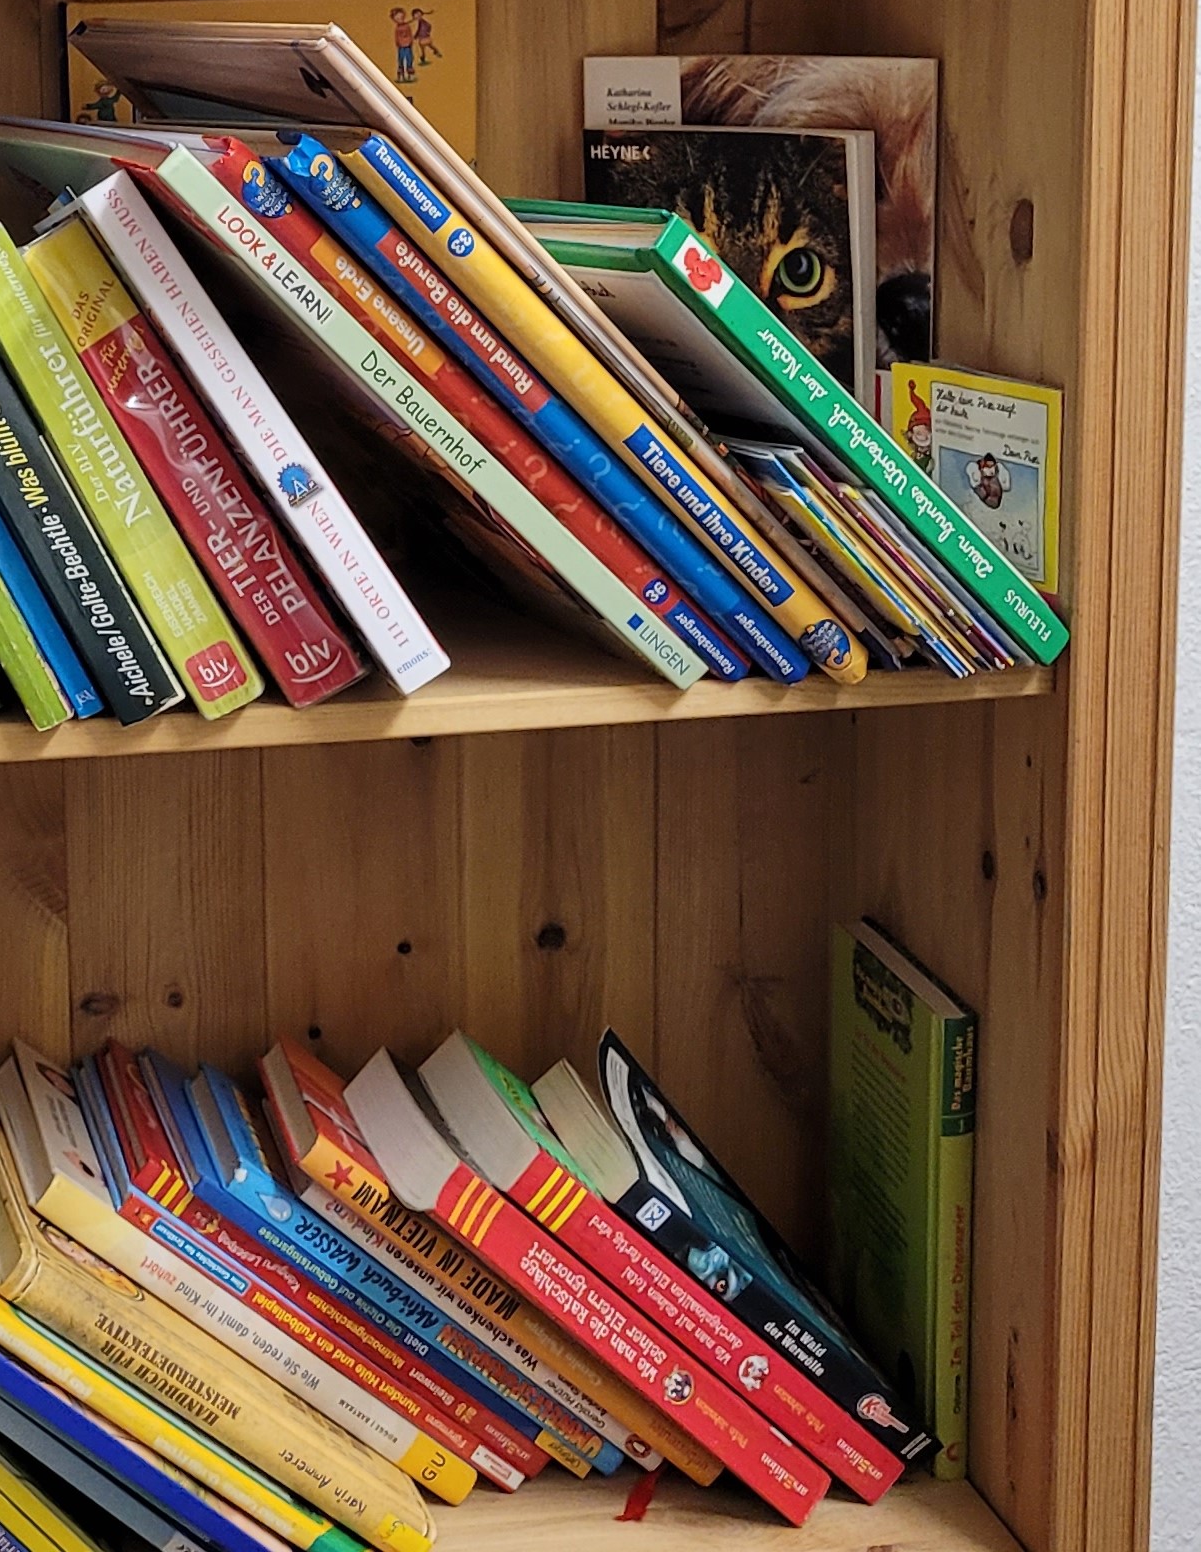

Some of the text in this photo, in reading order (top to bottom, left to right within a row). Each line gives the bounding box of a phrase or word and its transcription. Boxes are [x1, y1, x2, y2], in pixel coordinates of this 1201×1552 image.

[371, 145, 444, 223] Ravensburger
[215, 205, 268, 258] LOOK
[258, 251, 278, 270] &
[270, 261, 334, 326] LEARN!
[329, 255, 376, 303] Erde
[366, 293, 429, 356] Unsere
[389, 239, 536, 395] Rund um die Berufe
[31, 340, 152, 526] Naturführer
[102, 186, 413, 649] 111 ORTE IN WIEN DIE MAN GESEHEN HABEN MUSS
[357, 349, 486, 476] Der Bauernhof
[638, 441, 783, 596] Tiere und ihre Kinder
[671, 609, 738, 675] Ravensburger
[729, 609, 797, 677] Ravensburger
[1001, 587, 1054, 642] FLEURUS
[285, 638, 331, 675] blv
[637, 624, 692, 676] LINGEN
[324, 1196, 386, 1250] Kindern?
[350, 1179, 522, 1321] MADE IN VIETNAM
[290, 1213, 441, 1332] Aktivbuch WASSER
[383, 1241, 437, 1288] unseren
[433, 1282, 457, 1305] wir
[452, 1298, 514, 1351] schenken
[509, 1343, 541, 1372] Was
[783, 1317, 827, 1358] Im Wald
[91, 1310, 242, 1421] MEISTERDETEKTIVE
[97, 1338, 220, 1428] HANDBUCH FÜR
[419, 1451, 448, 1484] GU
